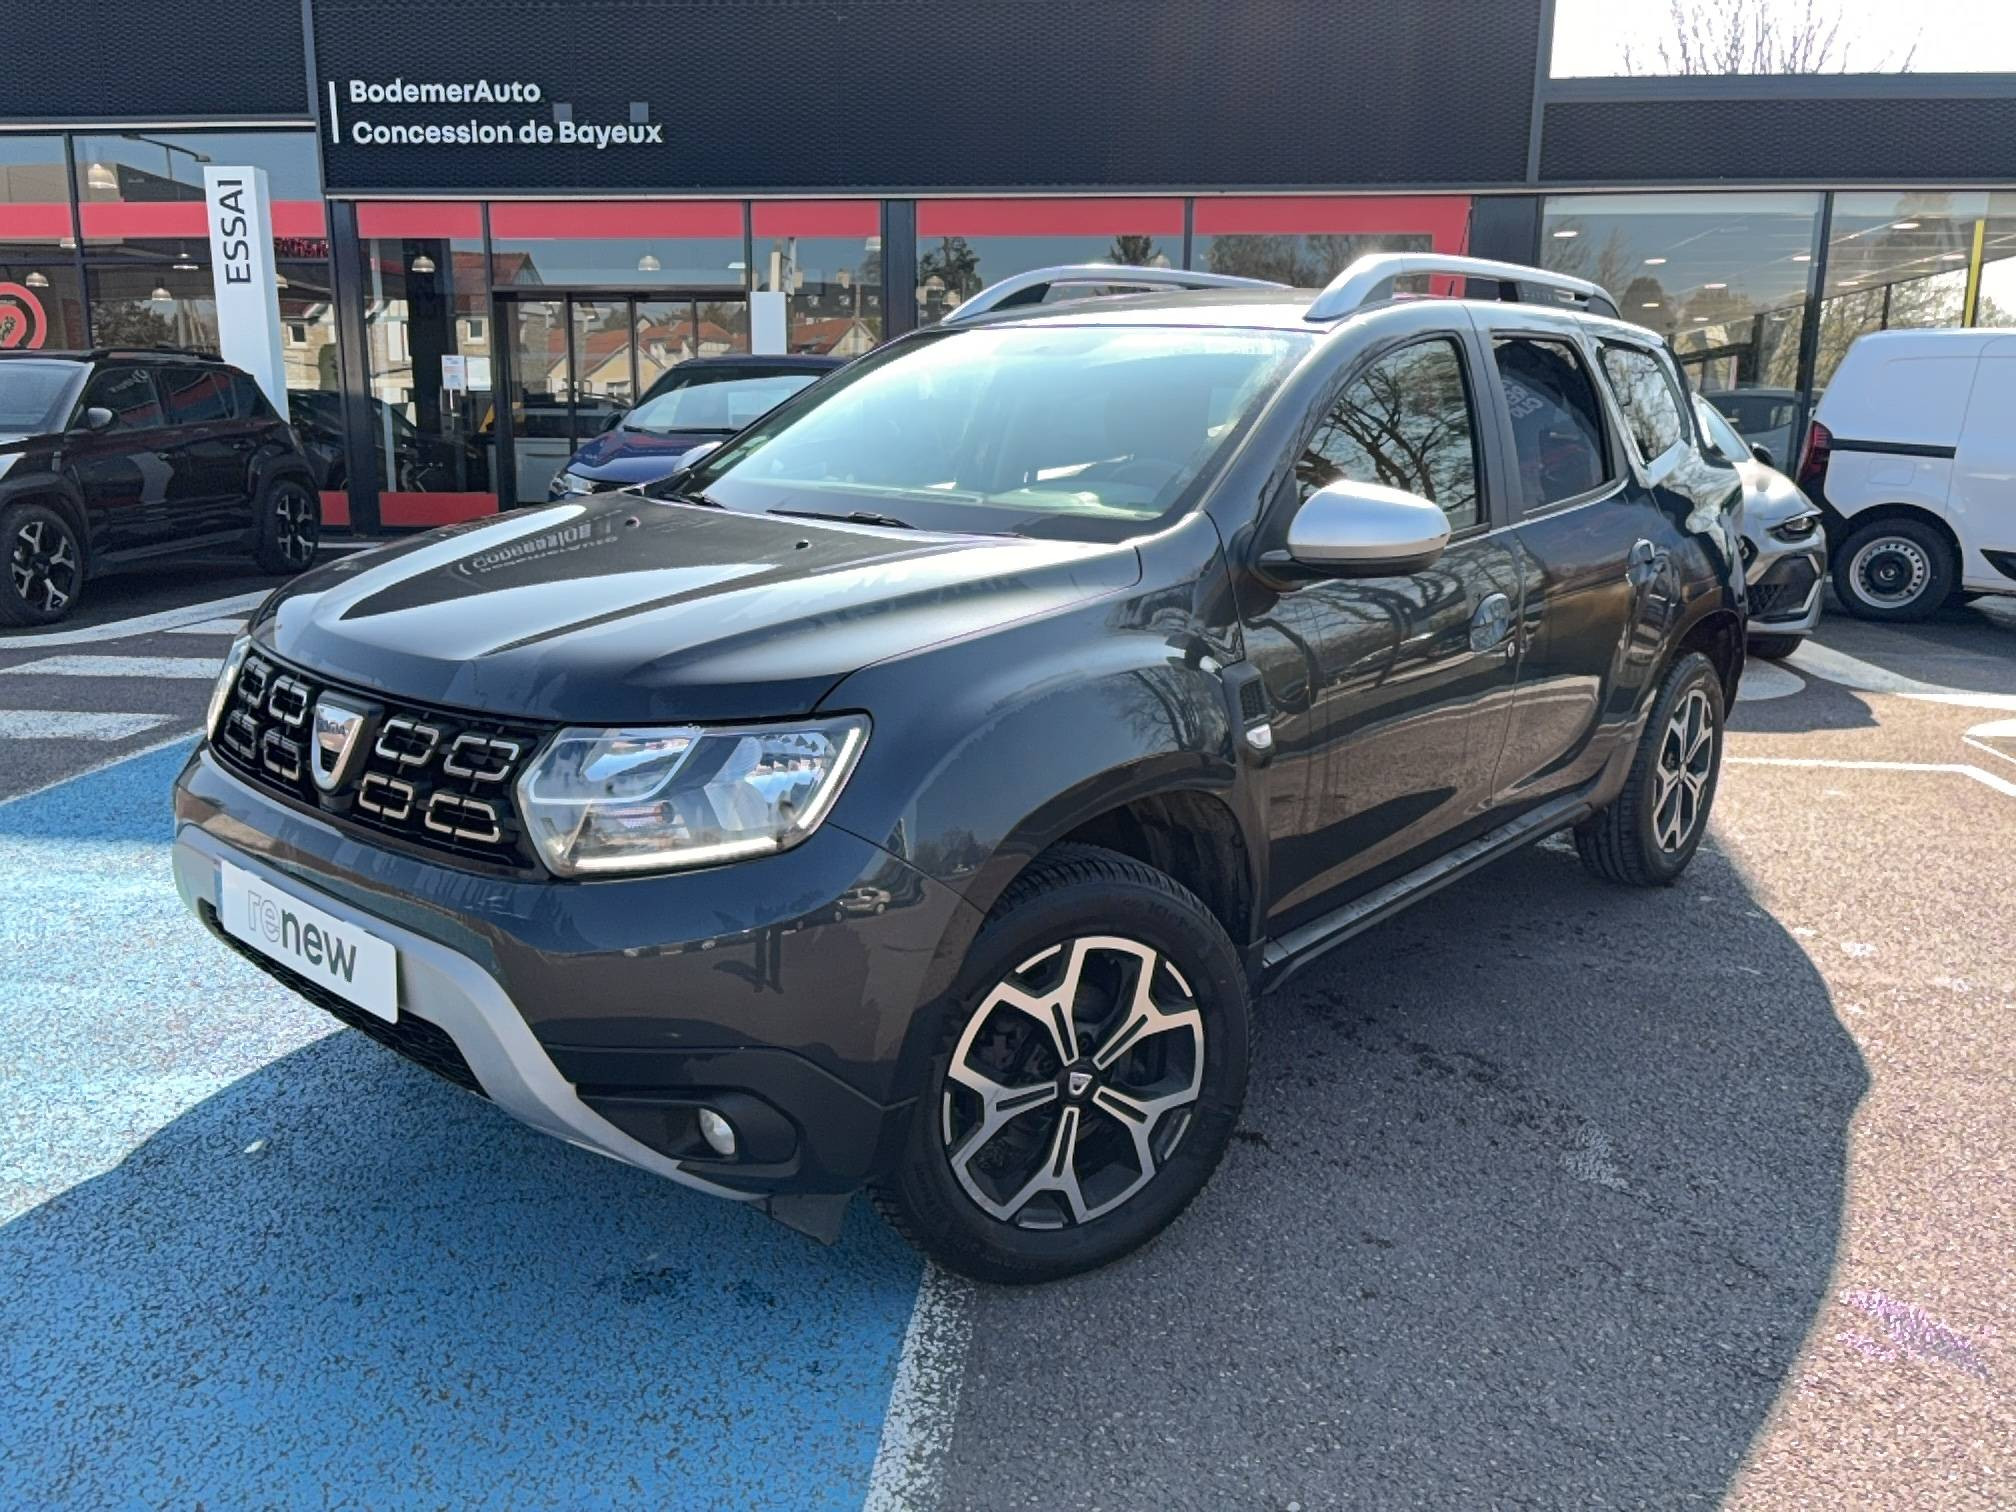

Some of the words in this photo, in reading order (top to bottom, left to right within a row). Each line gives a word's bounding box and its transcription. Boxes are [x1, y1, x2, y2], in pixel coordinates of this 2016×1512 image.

[349, 78, 541, 103] BodemerAuto
[352, 120, 513, 144] Concession
[519, 120, 554, 144] de
[559, 121, 663, 149] Bayeux
[217, 180, 251, 284] ESSAI
[248, 889, 357, 983] renew
